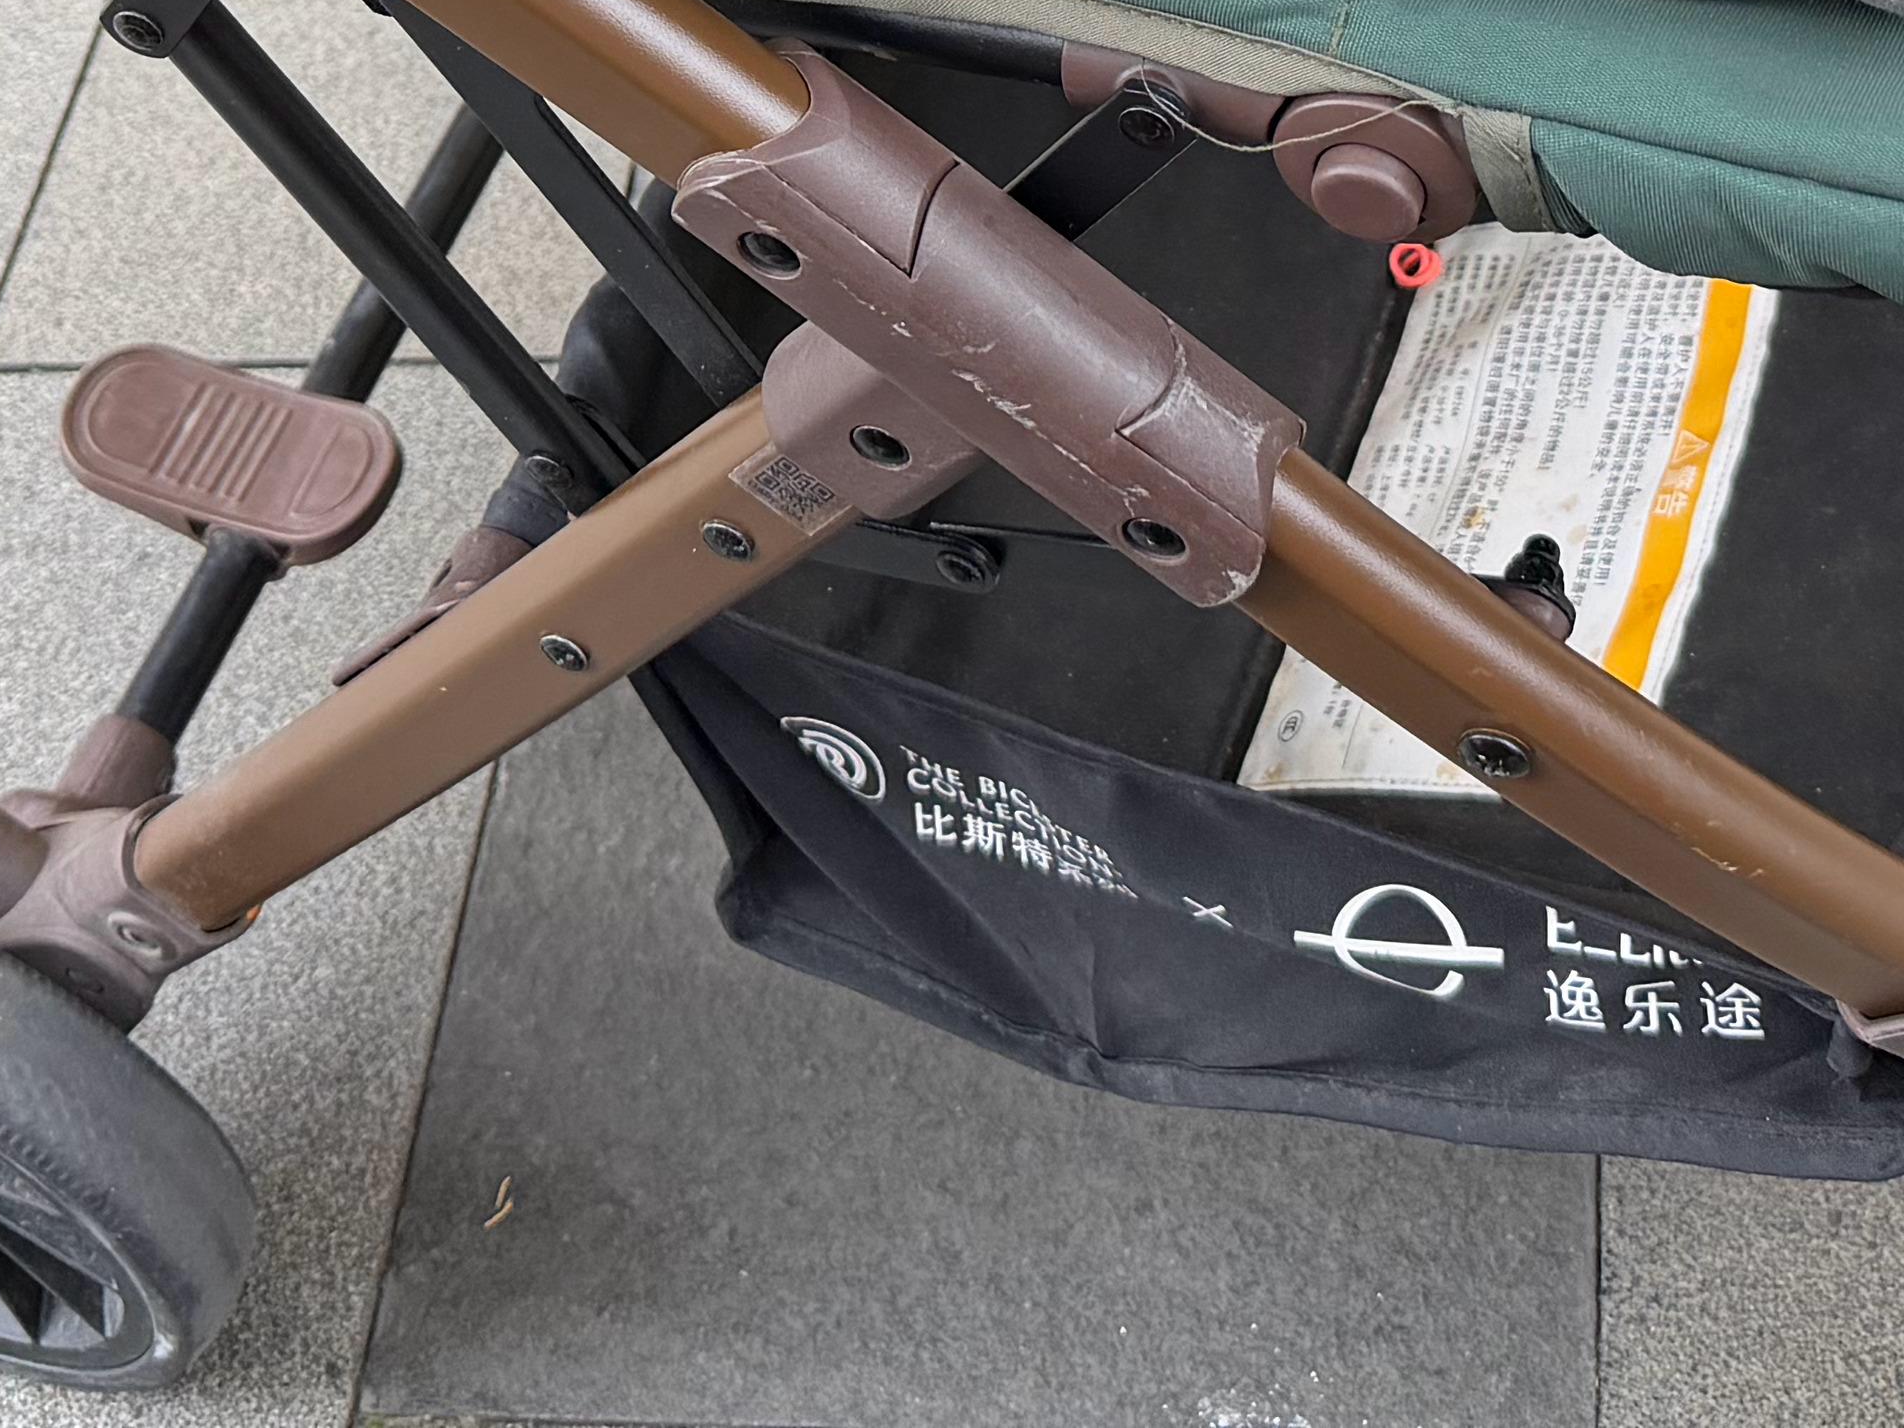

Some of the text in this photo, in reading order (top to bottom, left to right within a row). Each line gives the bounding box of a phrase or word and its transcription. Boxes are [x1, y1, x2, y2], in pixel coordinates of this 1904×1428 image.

[1652, 466, 1697, 519] 警告
[899, 745, 964, 786] THE
[1543, 968, 1767, 1040] 逸乐途
